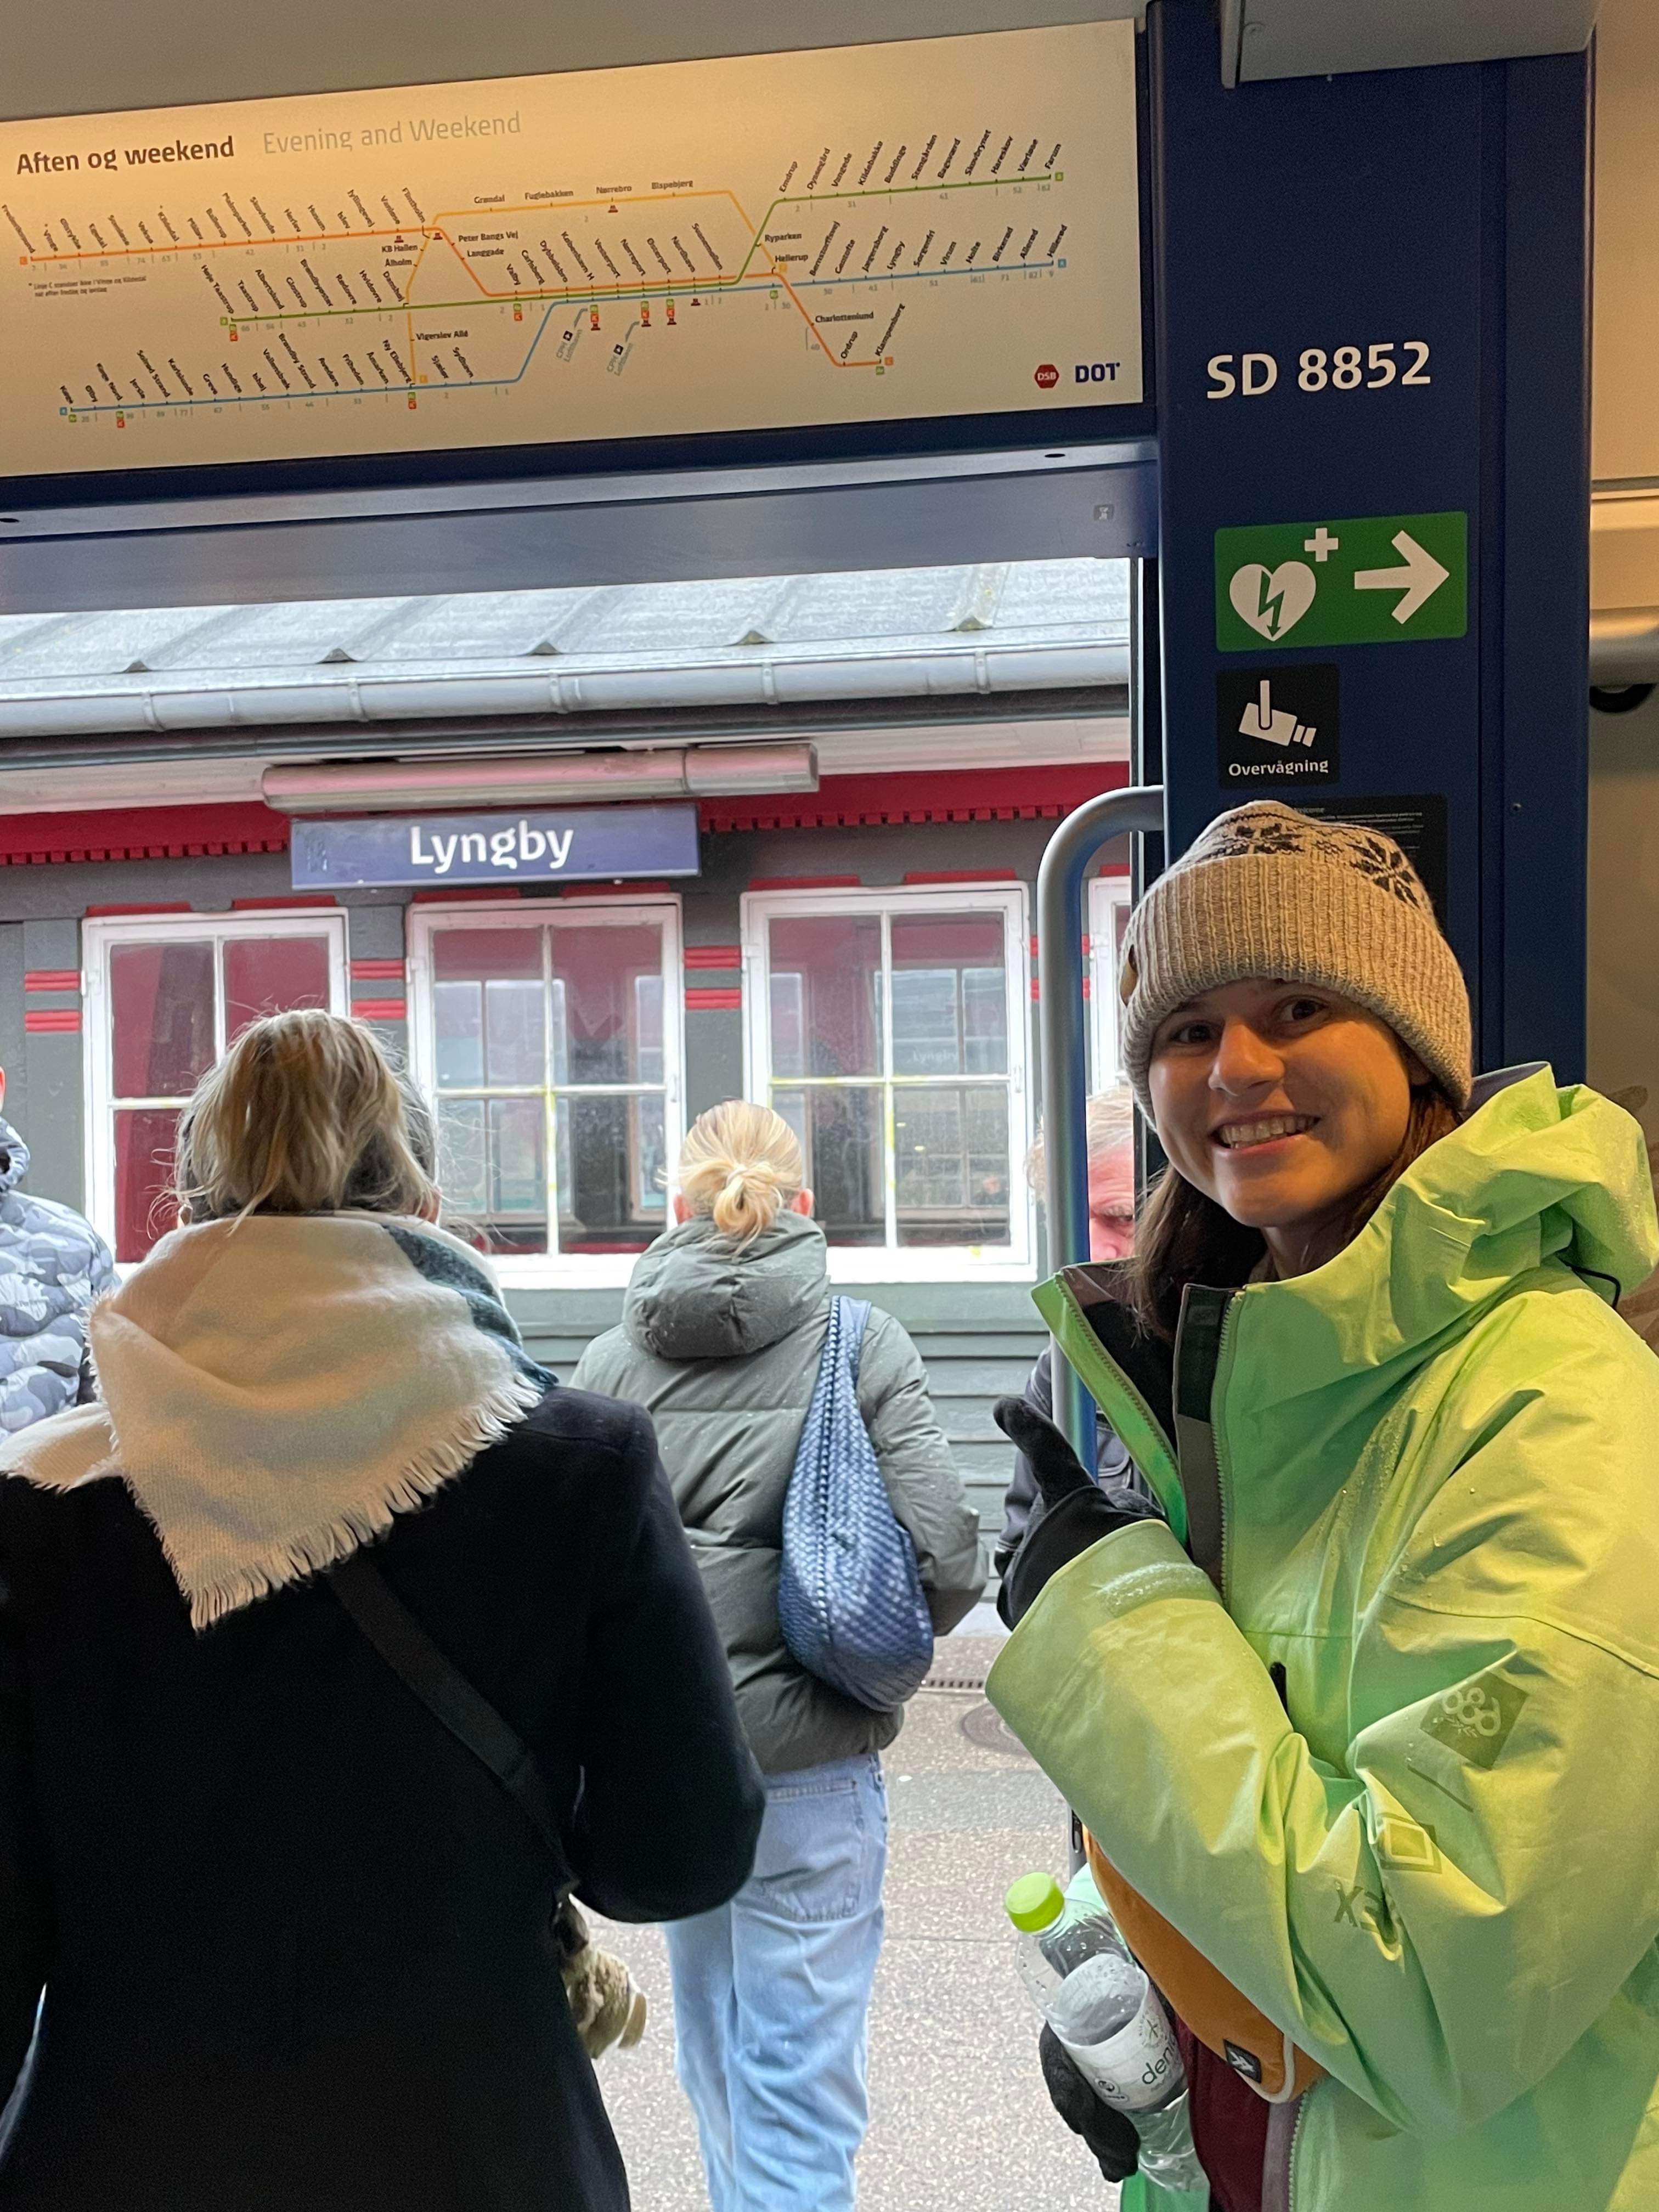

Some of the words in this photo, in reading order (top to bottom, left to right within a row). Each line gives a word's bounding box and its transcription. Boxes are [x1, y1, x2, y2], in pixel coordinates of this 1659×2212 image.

[263, 131, 353, 154] Evening
[360, 121, 402, 148] and
[409, 112, 521, 142] Weekend
[16, 151, 80, 175] Aften
[88, 149, 118, 172] og
[125, 136, 234, 166] weekend
[857, 140, 883, 185] Kildebakke
[884, 145, 907, 184] Buddinge
[911, 134, 938, 180] Stengården
[937, 138, 961, 179] Bagsværd
[965, 129, 992, 176] Skovbrynet
[991, 136, 1013, 174] Hareskov
[1045, 144, 1062, 170] Farum
[779, 161, 798, 193] Emdrup
[806, 147, 831, 190] Dyssegård
[831, 153, 853, 188] Vangede
[524, 190, 573, 200] Fuglebakken
[596, 184, 632, 194] Nørrebro
[284, 208, 301, 233] Herlev
[308, 204, 325, 231] Husum
[337, 211, 351, 229] Islev
[382, 245, 393, 253] KB
[458, 234, 479, 242] Peter
[481, 233, 505, 242] Bangs
[506, 230, 518, 240] Vej
[765, 233, 802, 242] Ryparken
[913, 229, 935, 268] Sorgenfri
[775, 254, 809, 263] Hellerup
[887, 241, 906, 270] Lyngby
[940, 241, 957, 266] Virum
[966, 241, 981, 264] Holte
[506, 263, 521, 285] Valby
[521, 250, 545, 285] Carlsberg
[587, 272, 595, 281] H
[213, 282, 234, 314] Taastrup
[238, 279, 259, 312] Taastrup
[255, 269, 285, 309] Albertslund
[286, 277, 307, 308] Glostrup
[359, 269, 382, 303] Hvidovre
[815, 311, 874, 323] Charlottenlund
[875, 303, 905, 357] Klampenborg
[383, 340, 392, 351] Ny
[416, 331, 452, 341] Vigerslev
[840, 331, 858, 359] Ordrup
[168, 358, 194, 396] Karlslunde
[221, 363, 242, 393] Hundige
[297, 364, 317, 388] Strand
[342, 353, 365, 385] Friheden
[1037, 371, 1057, 381] DSB
[1075, 363, 1117, 383] DOT
[1207, 353, 1277, 399] SD
[1298, 341, 1431, 391] 8852
[109, 382, 123, 401] Nord
[129, 379, 145, 399] Jersie
[153, 374, 171, 397] Strand
[202, 374, 218, 394] Greve
[1228, 759, 1328, 776] Overvågning
[409, 820, 574, 873] Lyngby
